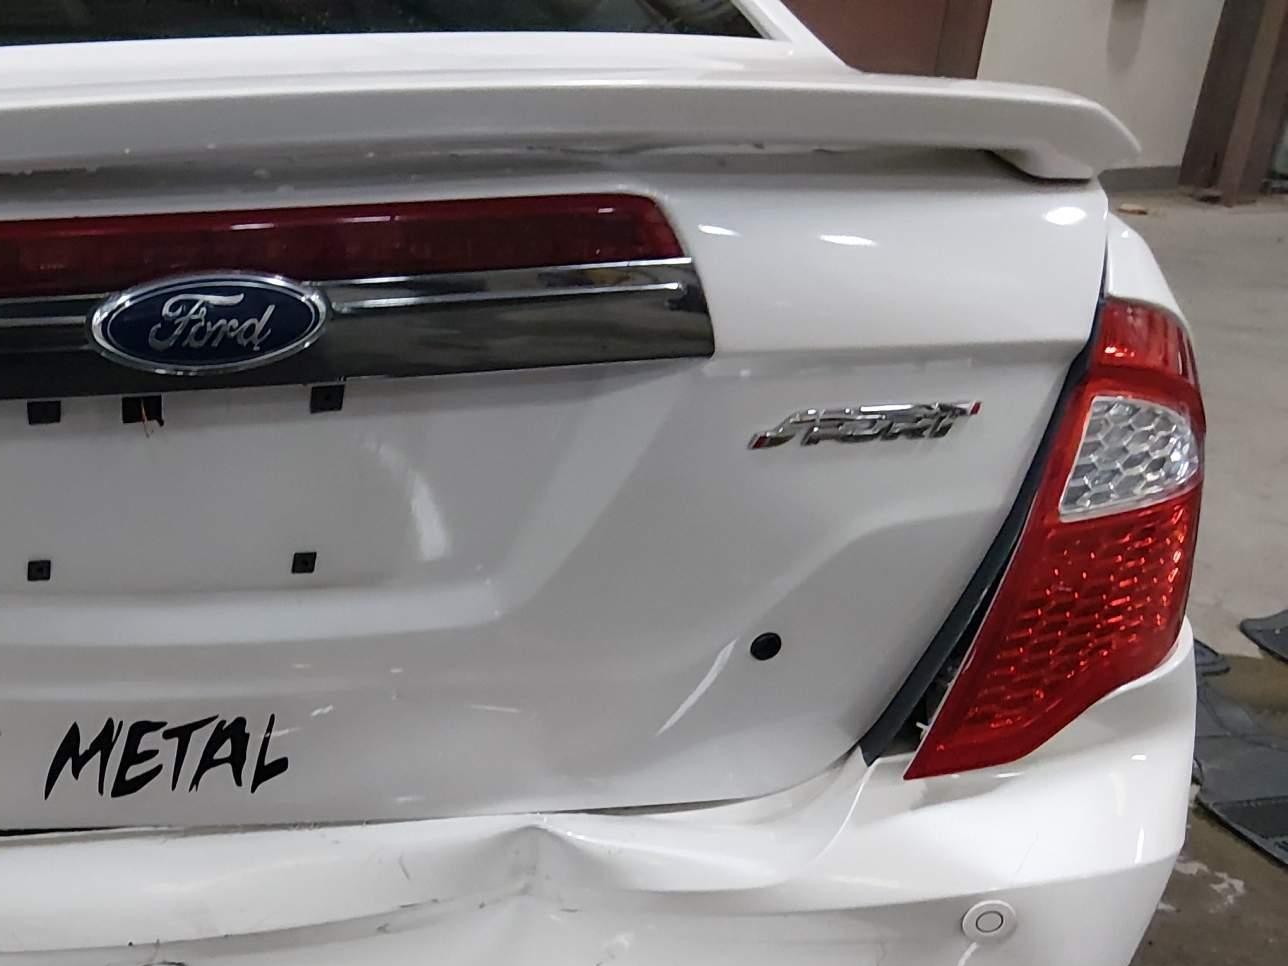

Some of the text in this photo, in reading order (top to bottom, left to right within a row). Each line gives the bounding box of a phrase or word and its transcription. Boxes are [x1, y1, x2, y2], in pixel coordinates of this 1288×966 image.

[149, 293, 275, 351] Ford
[748, 401, 982, 449] SPORT
[44, 713, 289, 801] METAL
